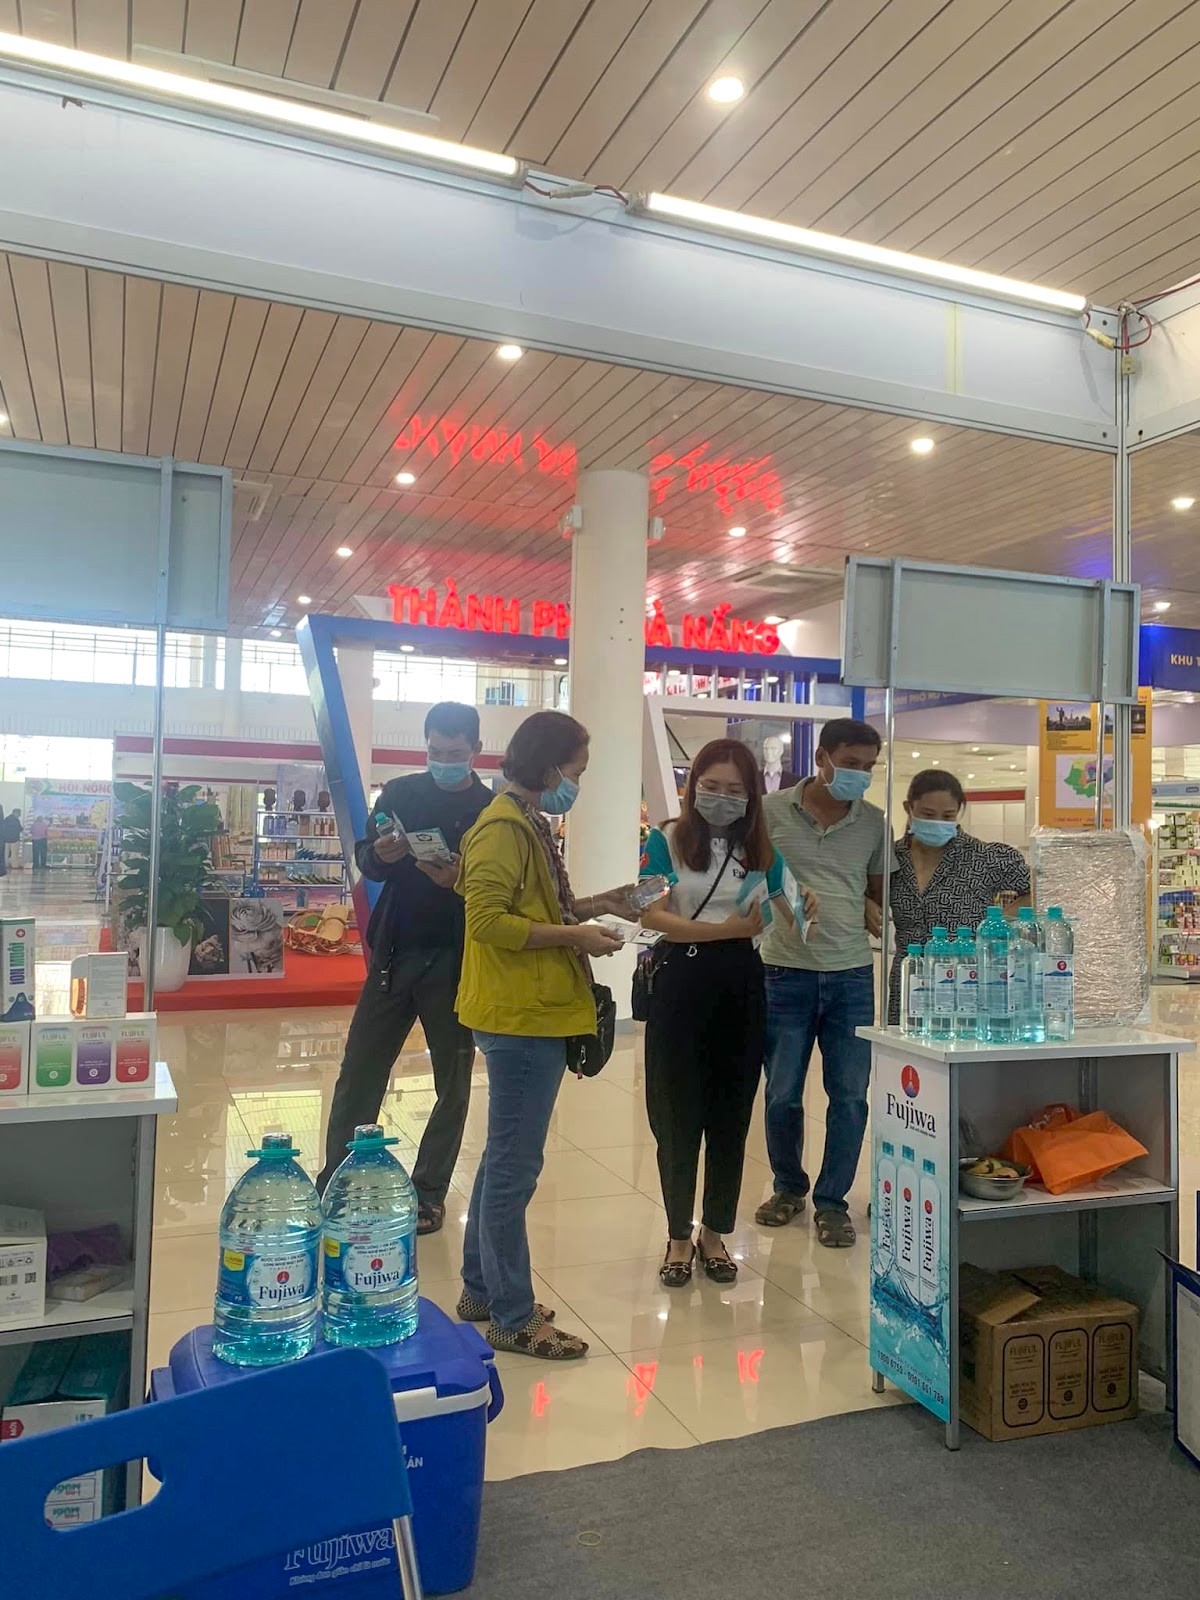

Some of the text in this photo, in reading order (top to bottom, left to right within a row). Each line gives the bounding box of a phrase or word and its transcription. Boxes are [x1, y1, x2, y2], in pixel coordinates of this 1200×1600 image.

[388, 578, 520, 635] THÀNH
[532, 600, 571, 639] PH
[683, 602, 780, 655] NẴNG
[1171, 654, 1193, 666] KHU
[886, 1092, 936, 1132] Fujiwa
[901, 1206, 914, 1263] Fujiwa
[922, 1217, 935, 1273] Fujiwa
[258, 1284, 305, 1303] Fujiwa
[354, 1269, 399, 1288] Fujiwa
[406, 1456, 423, 1469] ÁN
[284, 1527, 396, 1570] Fujiwa
